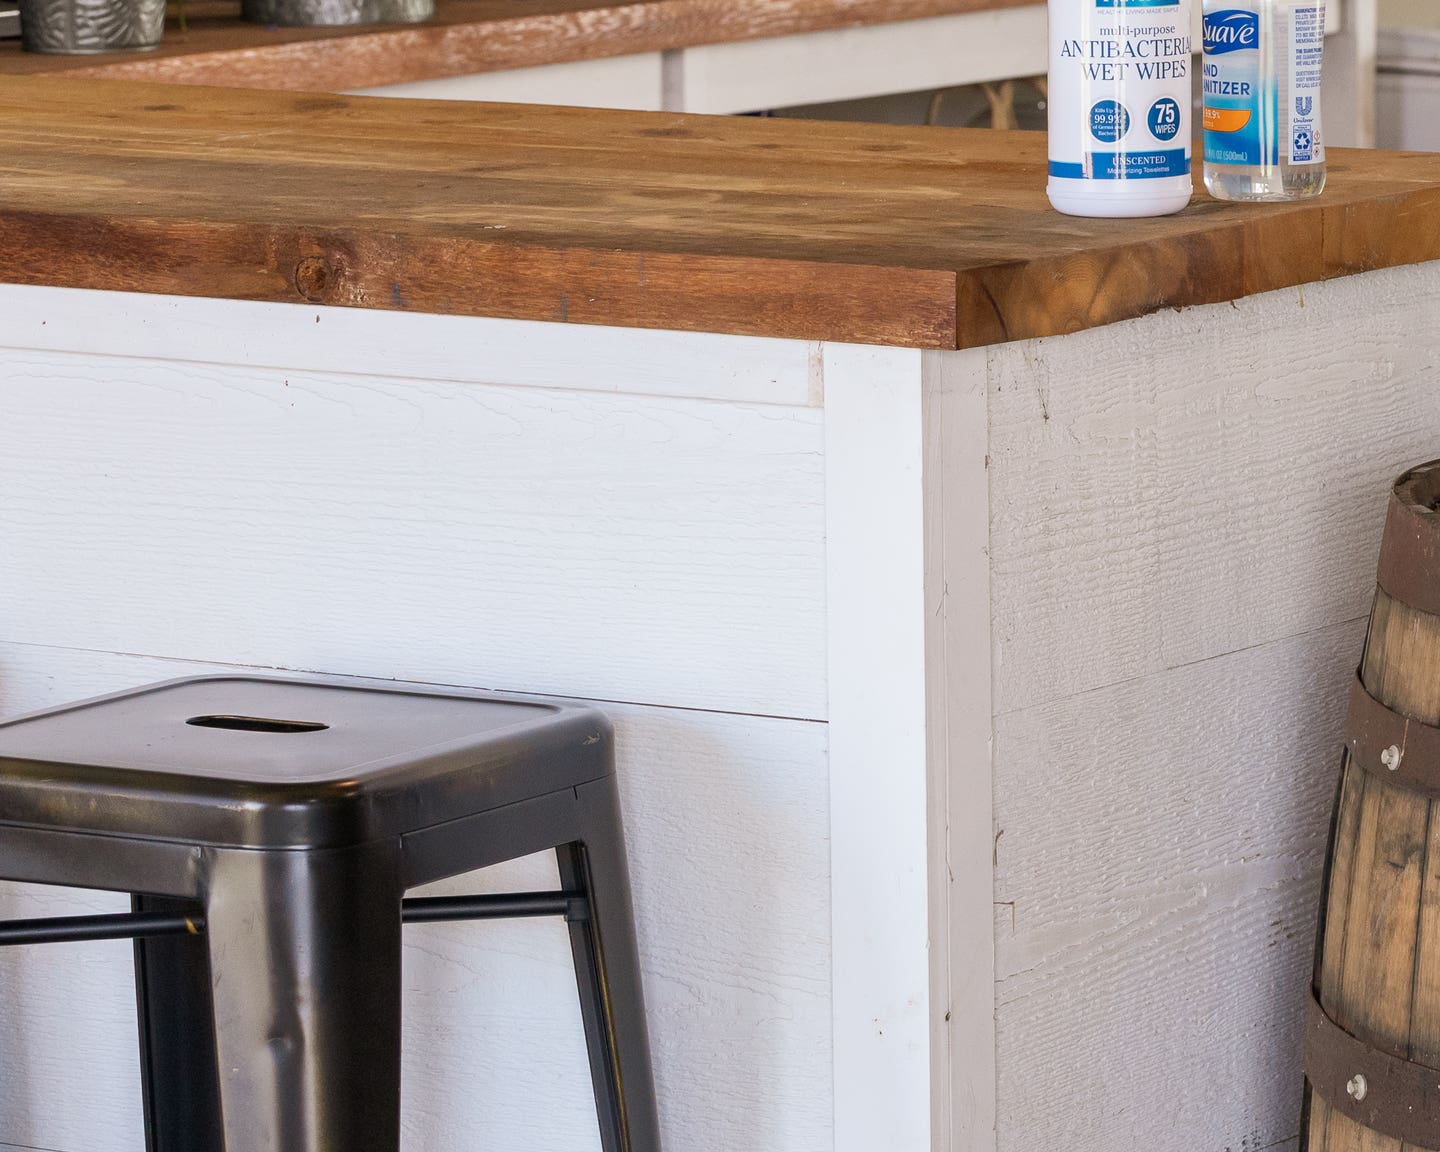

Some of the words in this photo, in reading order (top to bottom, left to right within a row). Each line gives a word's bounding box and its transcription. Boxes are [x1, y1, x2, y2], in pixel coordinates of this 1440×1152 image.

[1203, 17, 1255, 44] Suave
[1081, 62, 1129, 81] WET
[1135, 59, 1186, 81] WIPES
[1203, 63, 1218, 78] AND
[1203, 79, 1250, 96] ANITIZER
[1155, 103, 1175, 124] 75
[1155, 124, 1176, 135] WIPES
[1112, 155, 1166, 165] UNSCENTED
[1223, 151, 1248, 162] (500mL)
